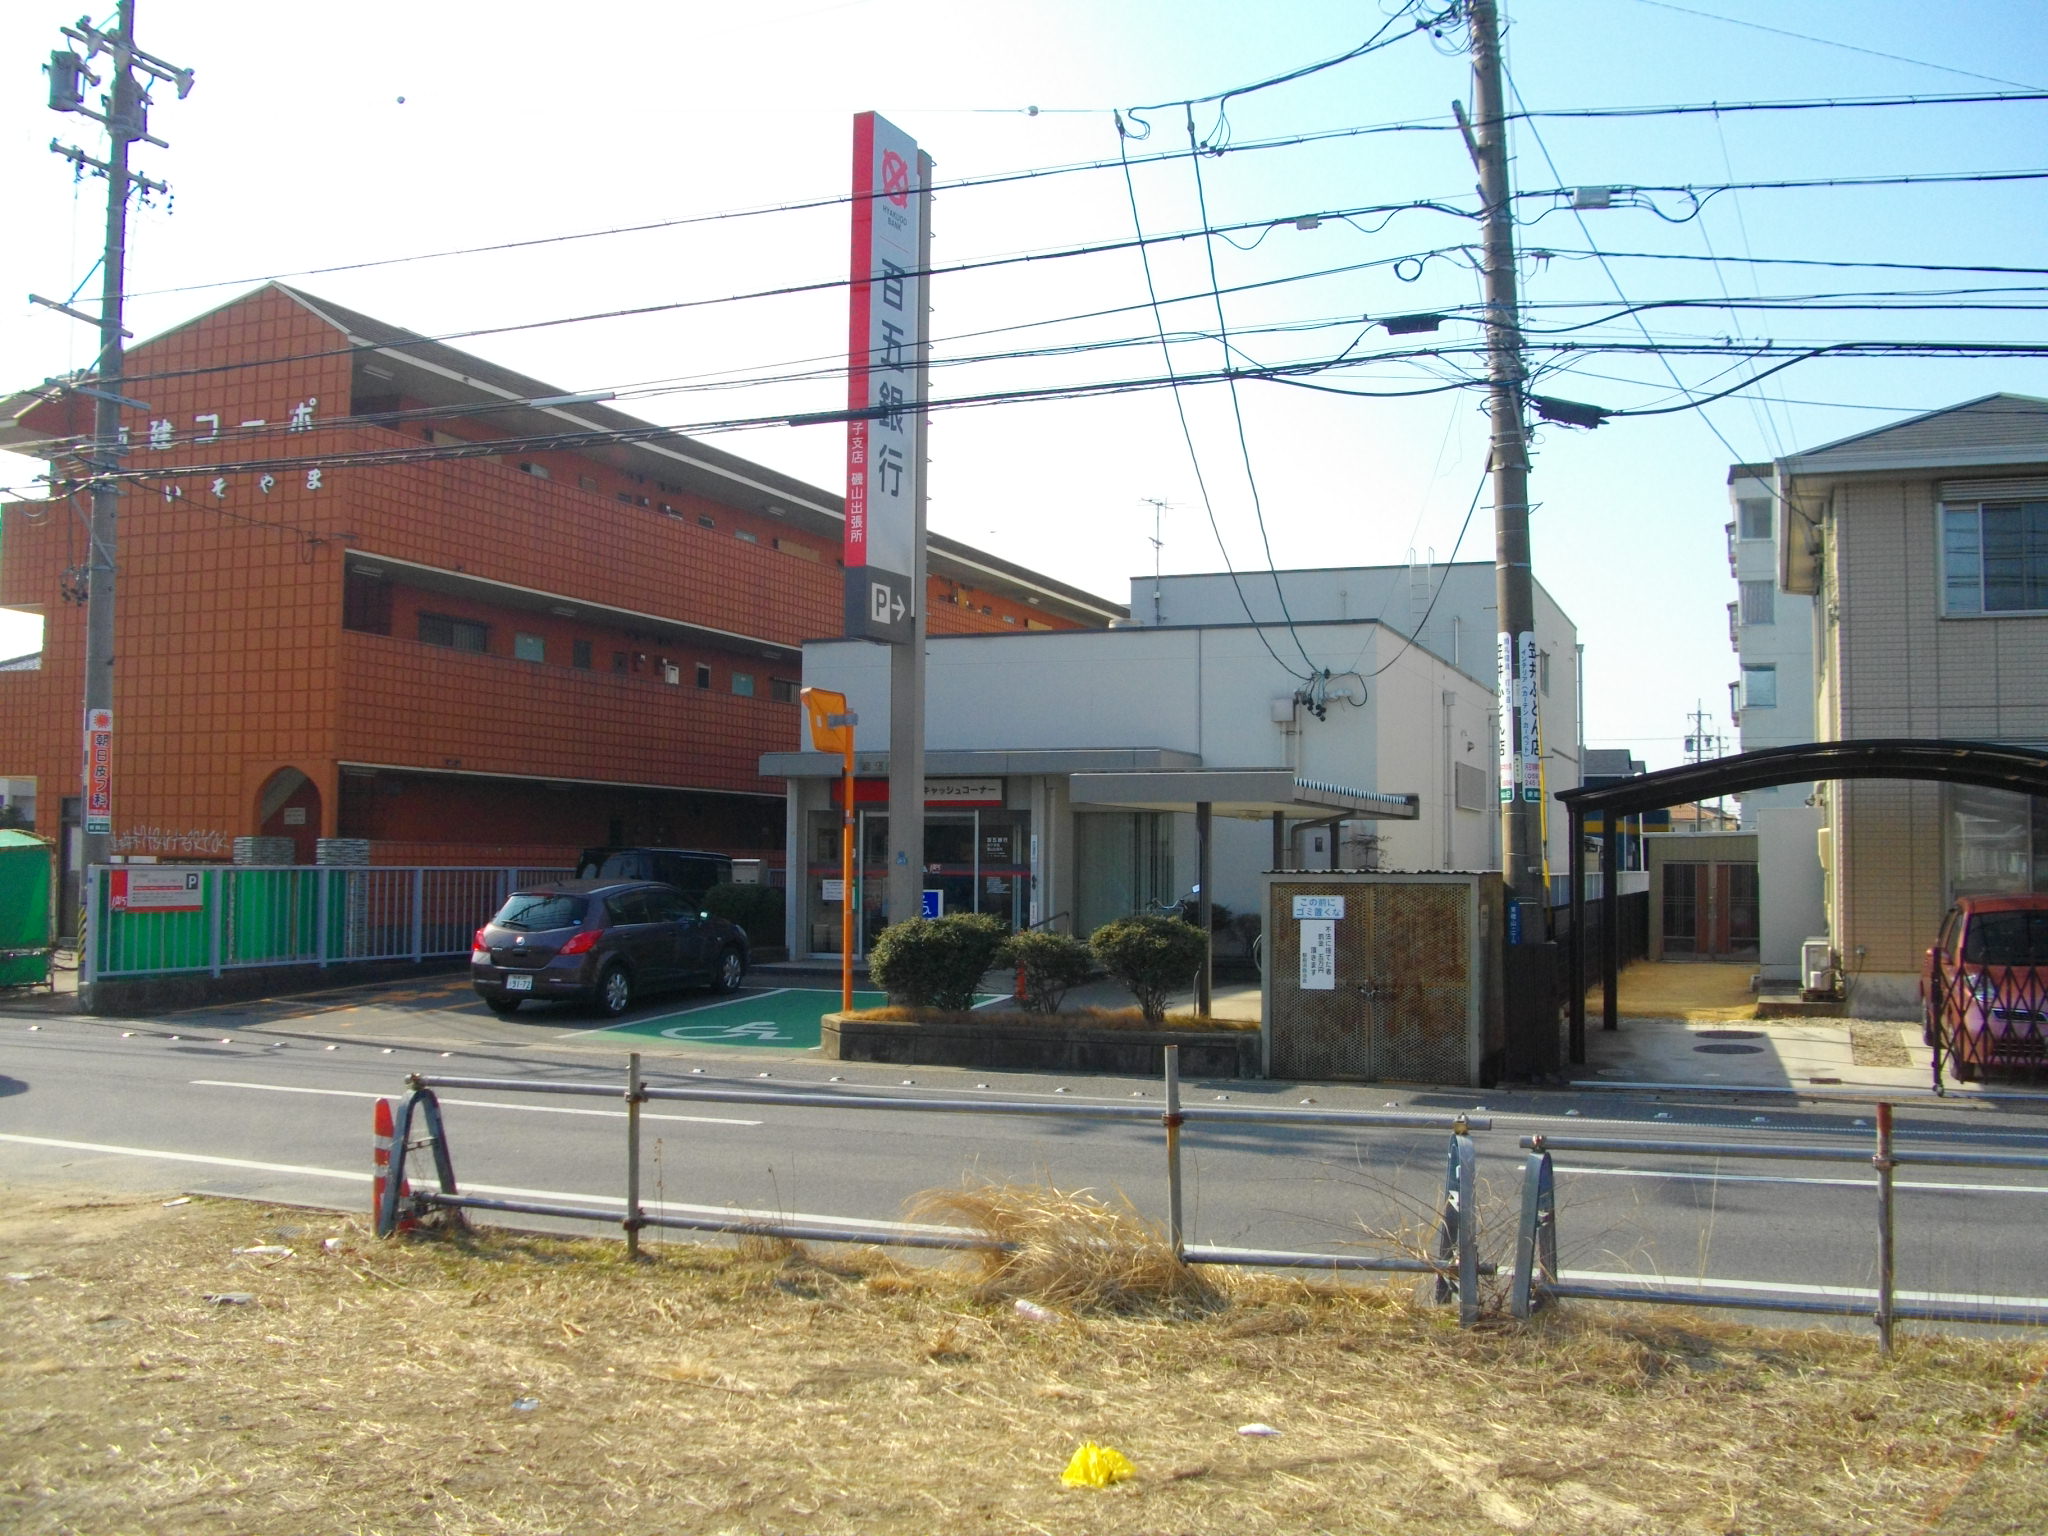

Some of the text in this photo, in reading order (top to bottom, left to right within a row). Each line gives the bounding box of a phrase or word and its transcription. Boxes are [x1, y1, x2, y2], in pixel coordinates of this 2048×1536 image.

[878, 257, 906, 498] 百五銀行
[165, 467, 323, 503] いそやま
[850, 422, 864, 543] 子支店 磯山出張所
[876, 586, 888, 618] P
[94, 733, 110, 808] 朝日皮フ科
[924, 785, 997, 795] キャッシュコーナー
[188, 875, 197, 888] P
[1296, 908, 1341, 917] ゴミ置くな
[1300, 898, 1336, 907] この前に
